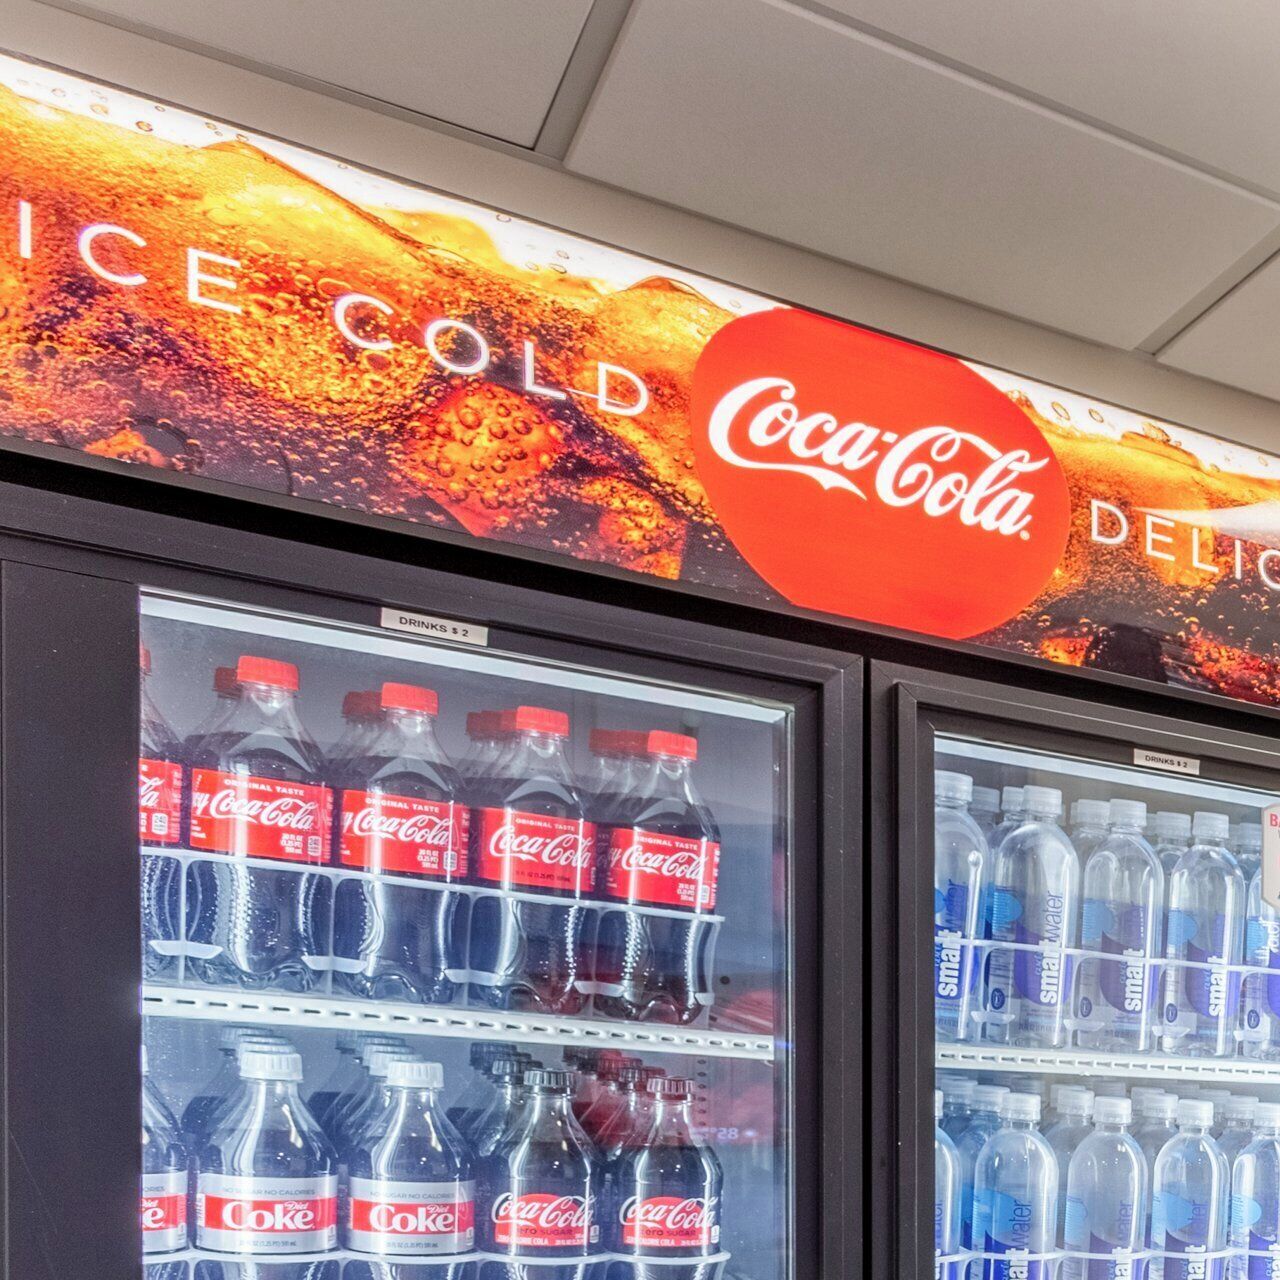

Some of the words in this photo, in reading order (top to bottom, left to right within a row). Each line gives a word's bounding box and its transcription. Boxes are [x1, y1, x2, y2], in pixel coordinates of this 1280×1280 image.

[19, 200, 243, 314] ICE
[333, 293, 649, 417] COLD
[708, 376, 1050, 541] Coca-Cola
[398, 615, 448, 635] DRINKS
[452, 626, 459, 637] $
[461, 627, 469, 638] 2
[1144, 754, 1175, 767] DRINKS
[225, 779, 273, 793] ORIGINAL
[276, 786, 304, 796] TASTE
[365, 798, 409, 810] ORIGINAL
[412, 804, 440, 813] TASTE
[210, 789, 319, 830] Coca-Cola
[353, 808, 454, 846] Coca-Cola
[515, 818, 552, 829] ORIGINAL
[555, 823, 576, 832] TASTE
[490, 824, 592, 868] Coca-Cola
[635, 835, 672, 847] ORIGINAL
[675, 842, 698, 850] TASTE
[621, 844, 708, 880] Coca-Cola
[1044, 890, 1064, 941] water
[1040, 939, 1060, 1004] smart
[1124, 948, 1144, 1012] smart
[1208, 956, 1227, 1017] smart
[222, 1202, 314, 1230] Coke
[369, 1204, 455, 1232] Coke
[427, 1204, 450, 1213] Diet
[491, 1192, 597, 1228] Coca-Cola
[618, 1195, 718, 1229] Coca-Cola
[1014, 1199, 1032, 1248] water
